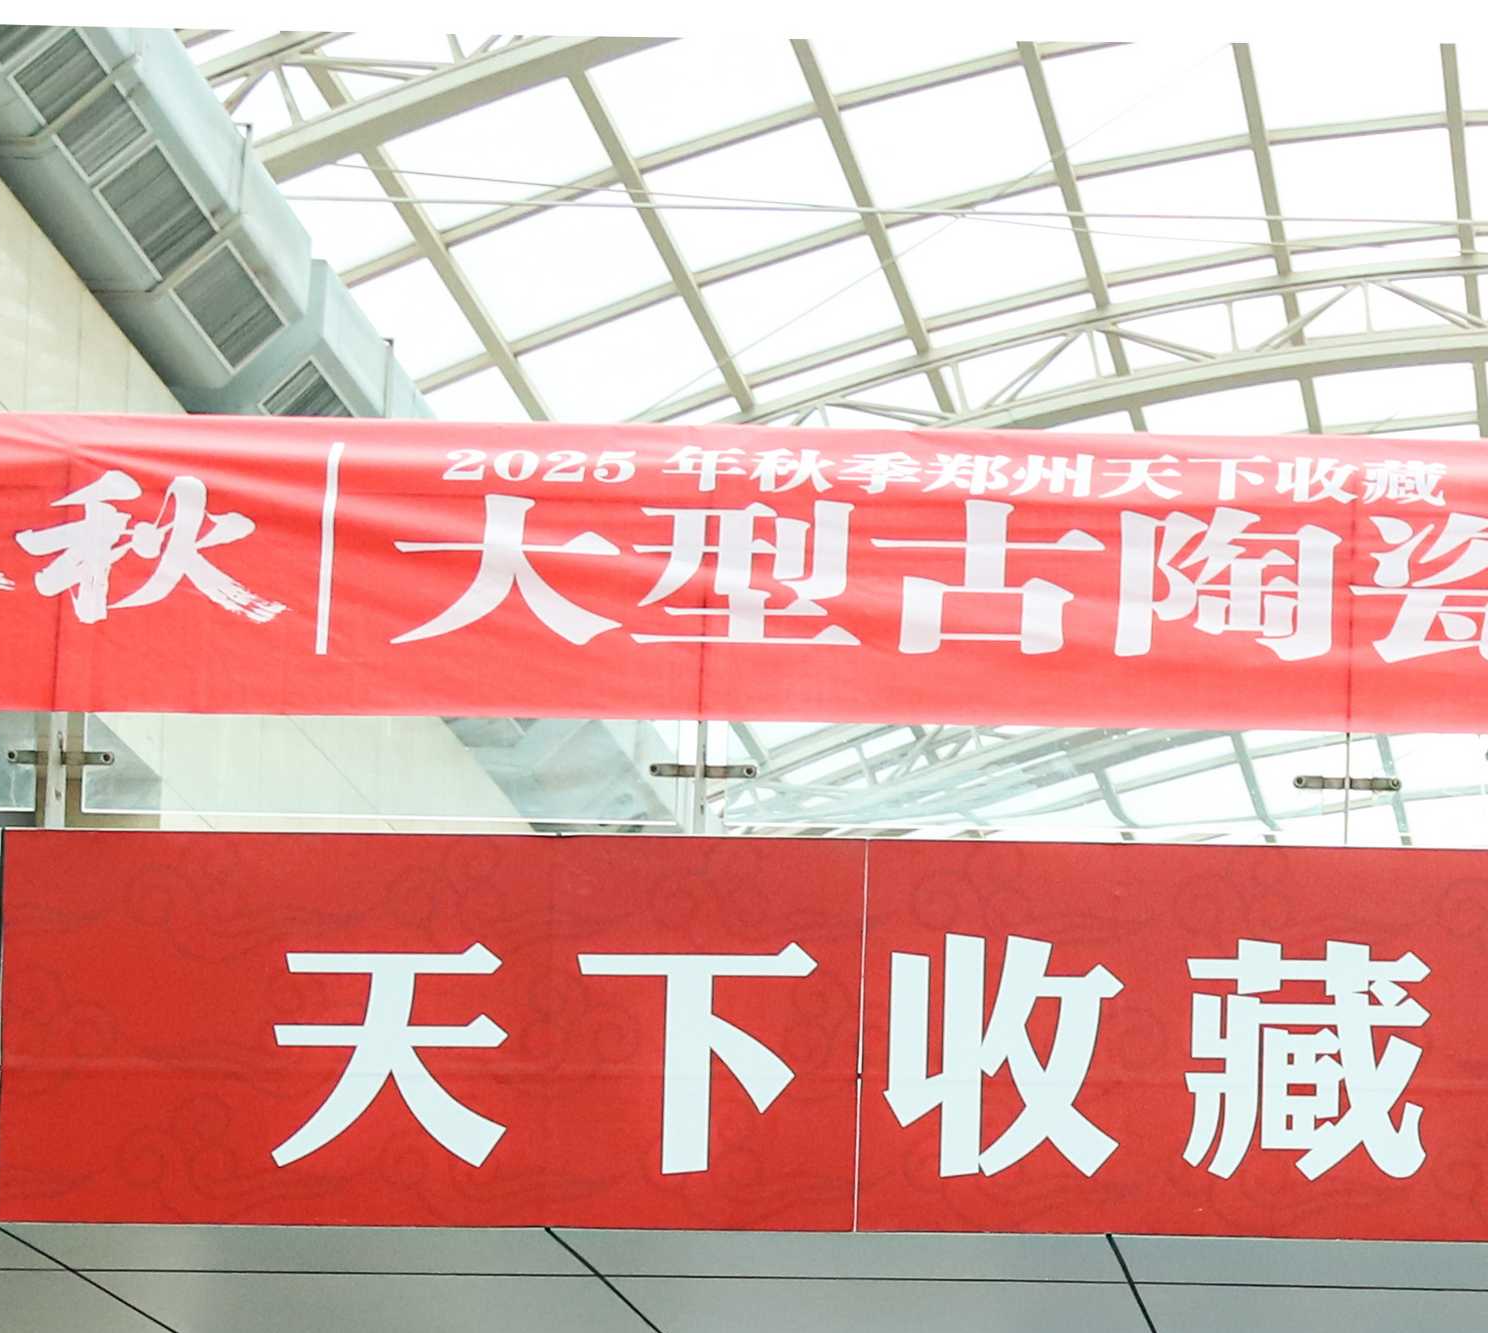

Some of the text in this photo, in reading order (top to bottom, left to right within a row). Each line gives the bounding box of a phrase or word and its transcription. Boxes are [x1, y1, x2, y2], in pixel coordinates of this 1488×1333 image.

[443, 449, 1448, 507] 2025 年秋季郑州天下收藏
[272, 933, 1430, 1180] 天下收藏
